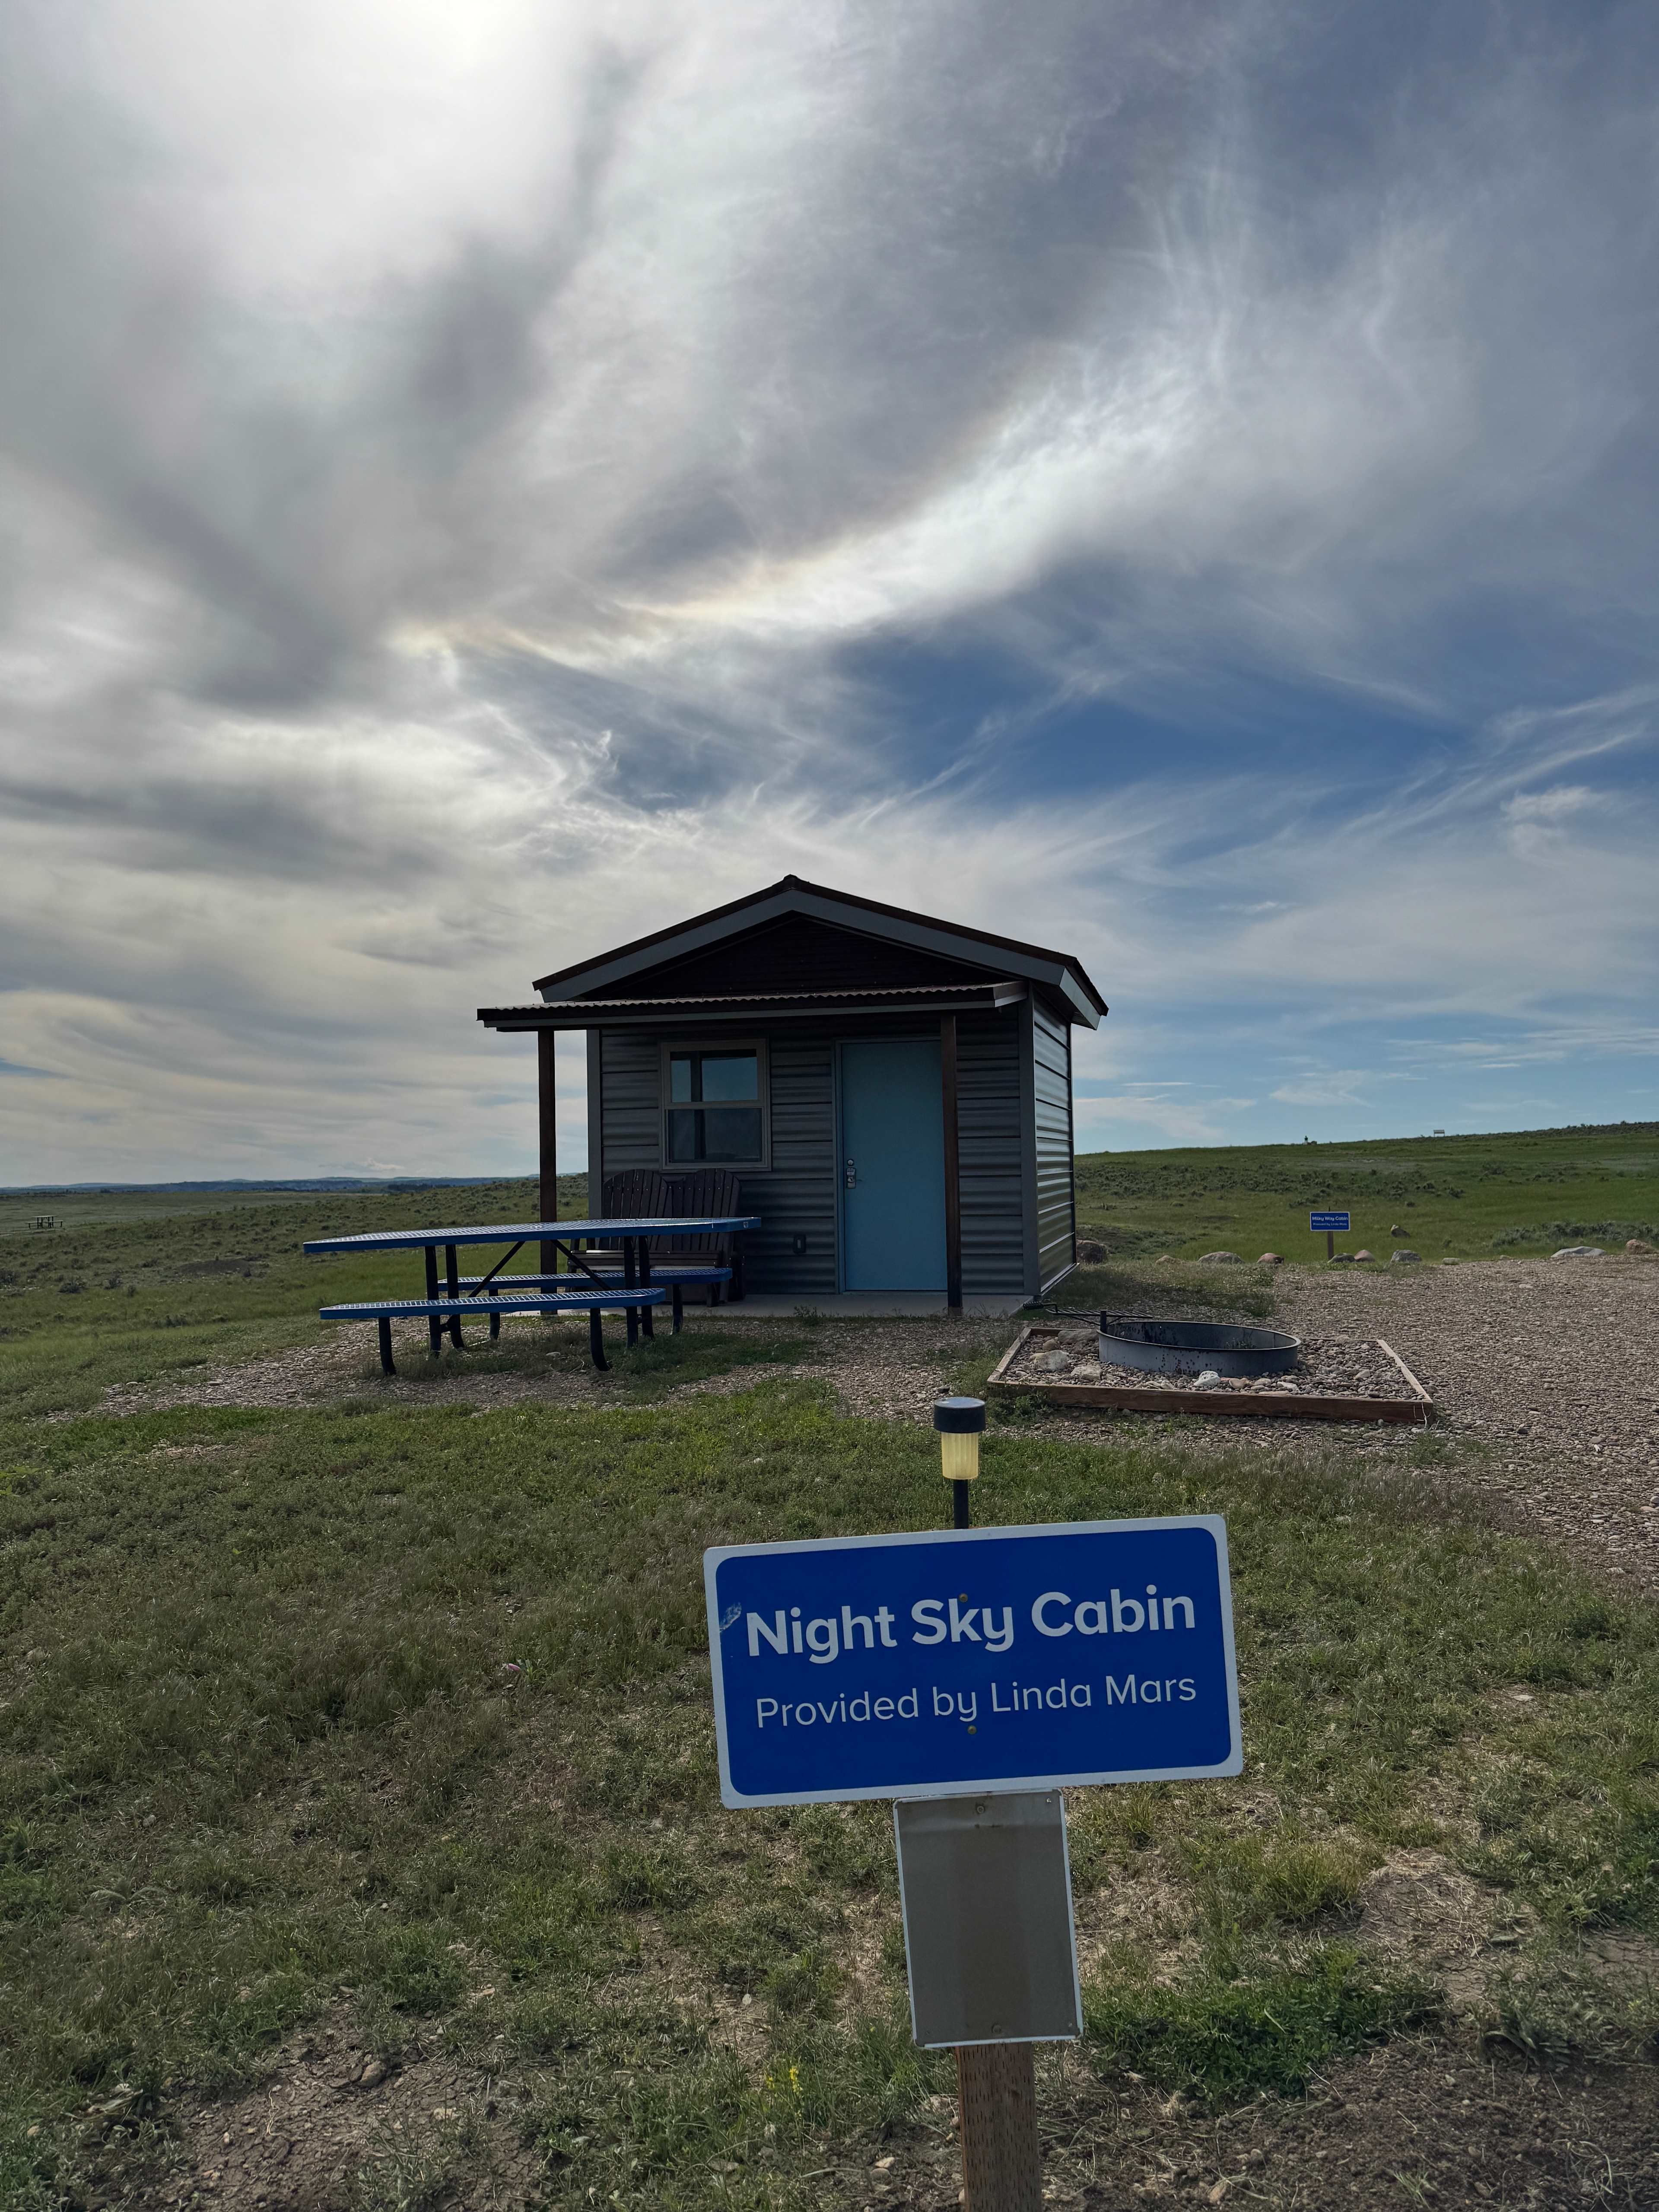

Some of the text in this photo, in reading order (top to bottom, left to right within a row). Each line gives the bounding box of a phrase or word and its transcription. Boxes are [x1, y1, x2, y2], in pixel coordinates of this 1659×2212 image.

[747, 1584, 1195, 1663] Night Sky Cabin
[757, 1675, 1196, 1728] Provided by Linda Mars
